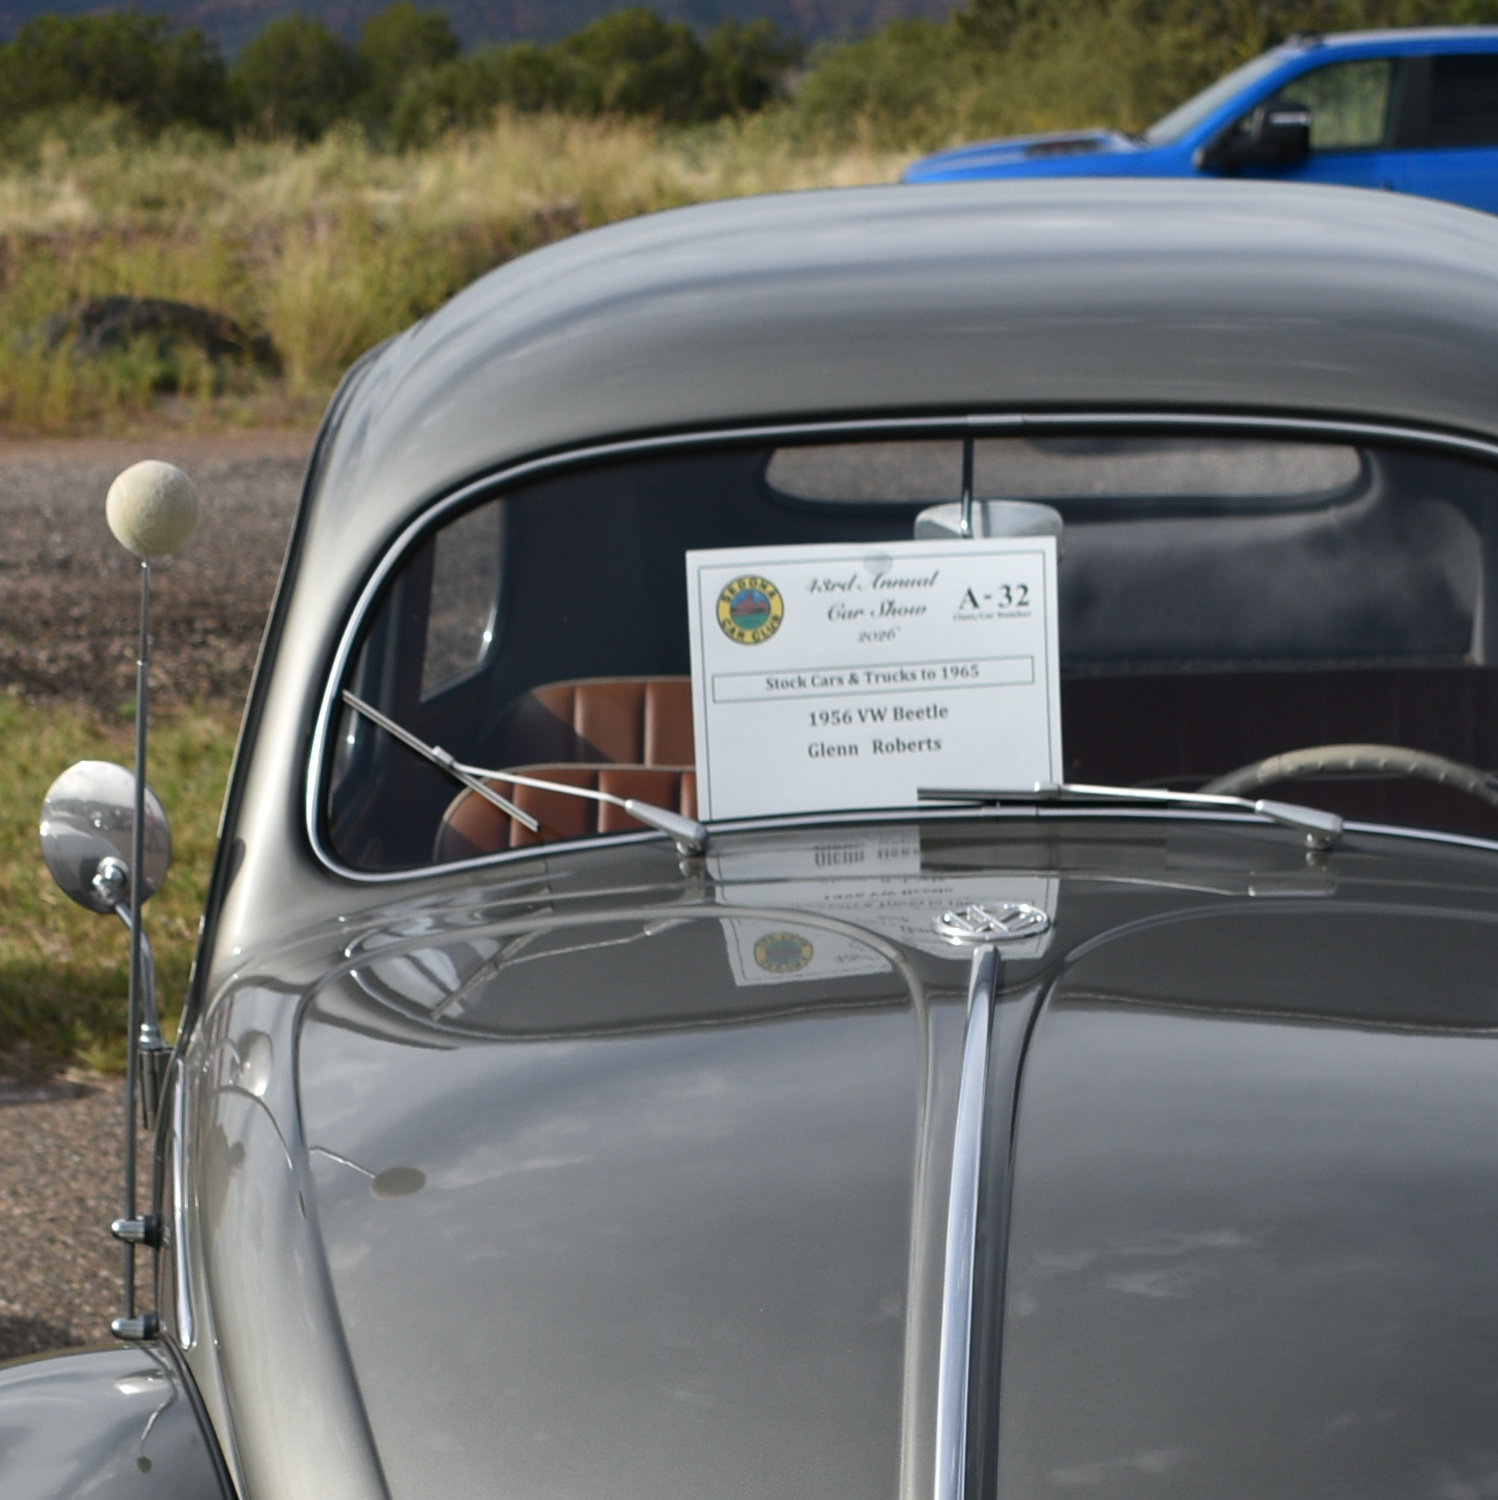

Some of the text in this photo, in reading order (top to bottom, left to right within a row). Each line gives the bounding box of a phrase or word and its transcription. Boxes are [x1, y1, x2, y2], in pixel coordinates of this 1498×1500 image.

[720, 575, 778, 603] SEDONA
[857, 568, 940, 591] Annual
[827, 598, 928, 622] Car Show
[721, 613, 782, 643] CAR CLUB
[765, 664, 980, 692] Stock Cars & Trucks to 1965
[809, 703, 949, 728] 1956 VW Beetle
[807, 737, 943, 759] Glenn Roberts
